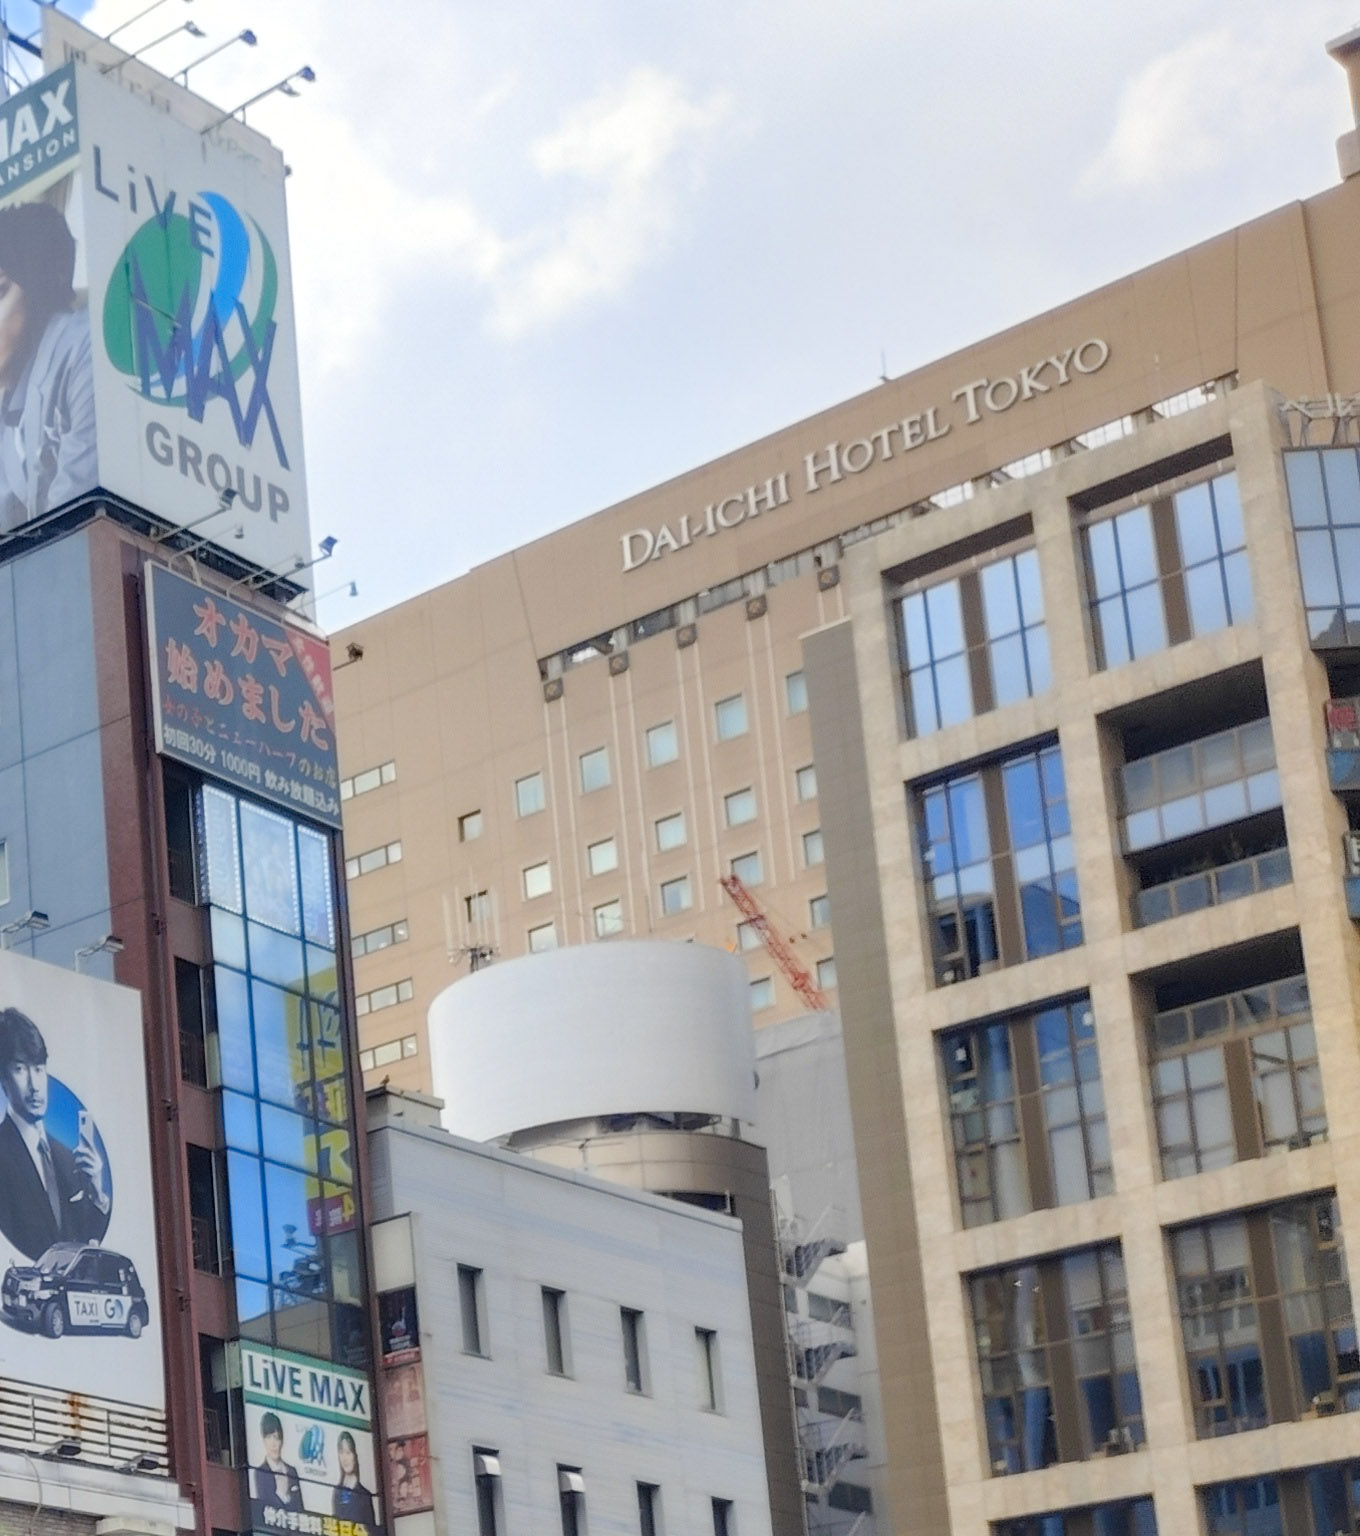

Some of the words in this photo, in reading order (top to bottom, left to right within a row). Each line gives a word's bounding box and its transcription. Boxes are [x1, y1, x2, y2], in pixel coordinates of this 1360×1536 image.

[804, 406, 952, 493] HOTEL
[952, 338, 1110, 425] TOKYO
[145, 421, 290, 524] GROUP
[193, 597, 293, 677] オカマ
[165, 637, 328, 750] 始めました
[221, 750, 261, 784] 1000円
[74, 1301, 98, 1316] TAXI
[310, 1371, 366, 1415] MAX
